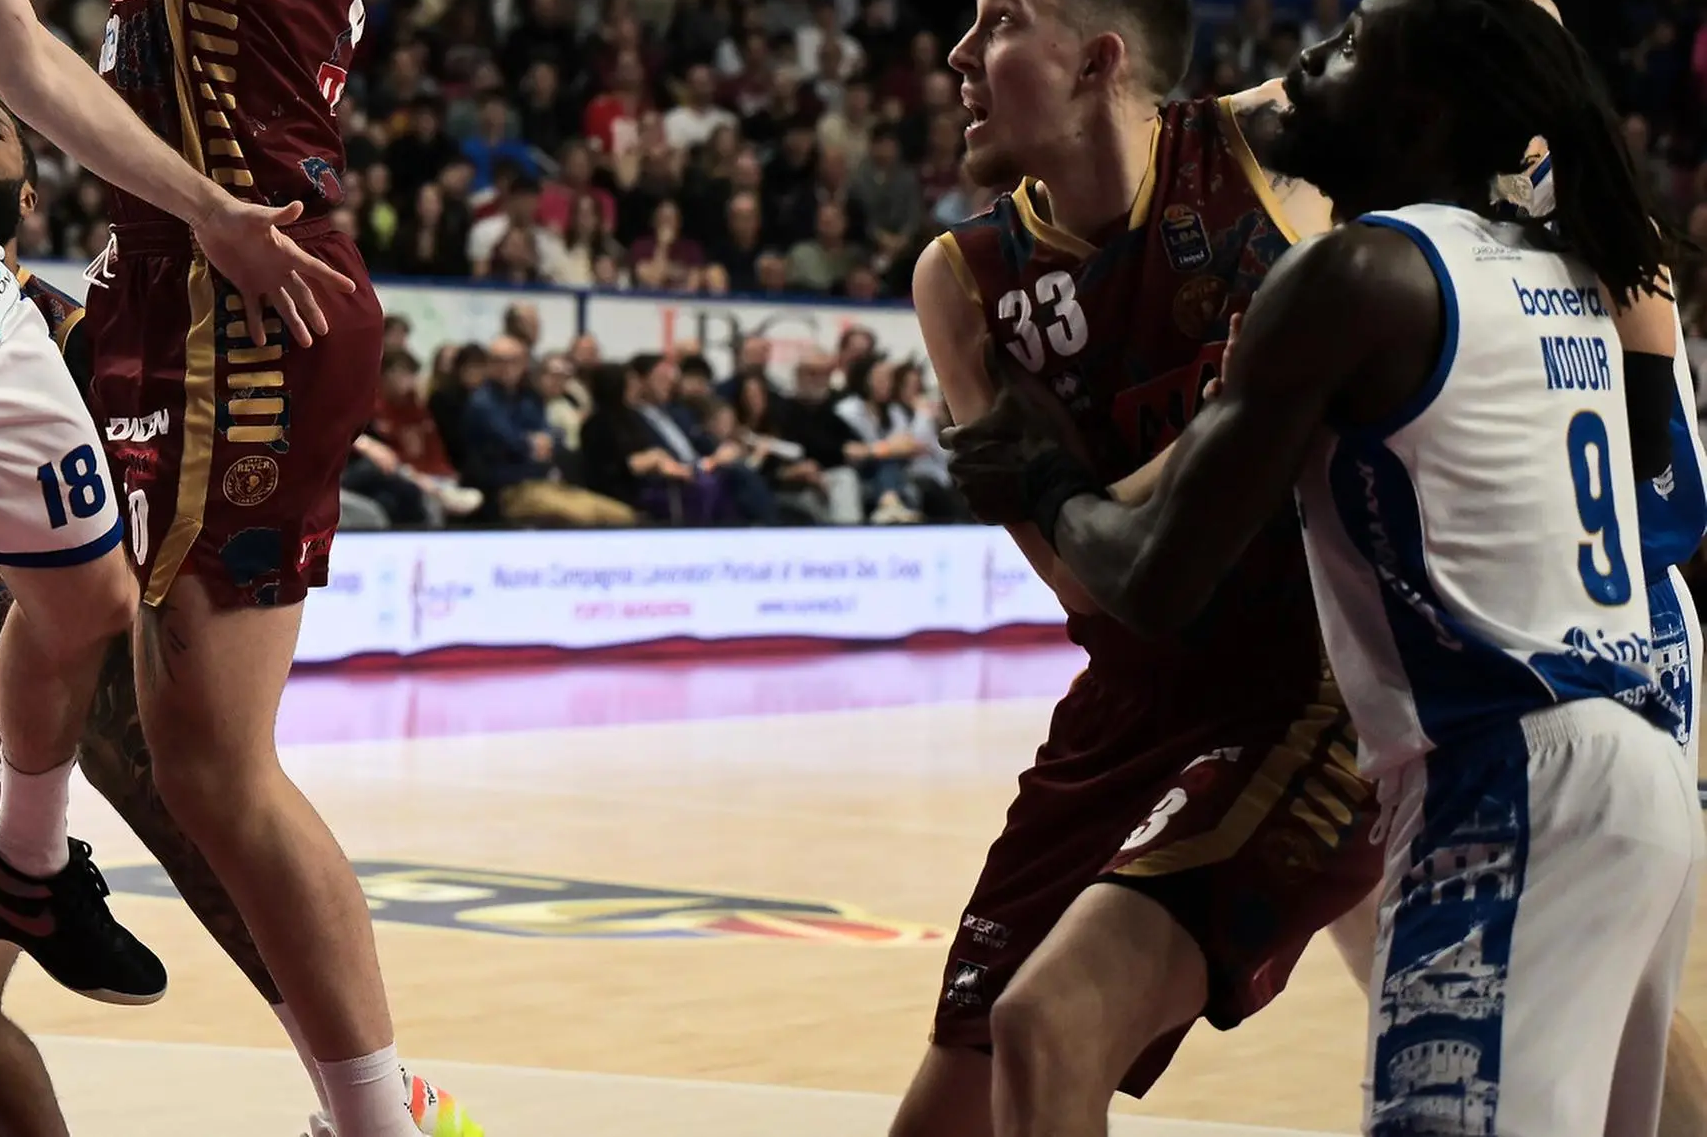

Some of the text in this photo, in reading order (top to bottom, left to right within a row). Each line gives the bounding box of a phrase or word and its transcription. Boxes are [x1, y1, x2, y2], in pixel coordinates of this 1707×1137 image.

[997, 270, 1089, 373] 33
[1540, 336, 1611, 391] NDOUR
[37, 444, 106, 529] 18
[1567, 409, 1631, 607] 9
